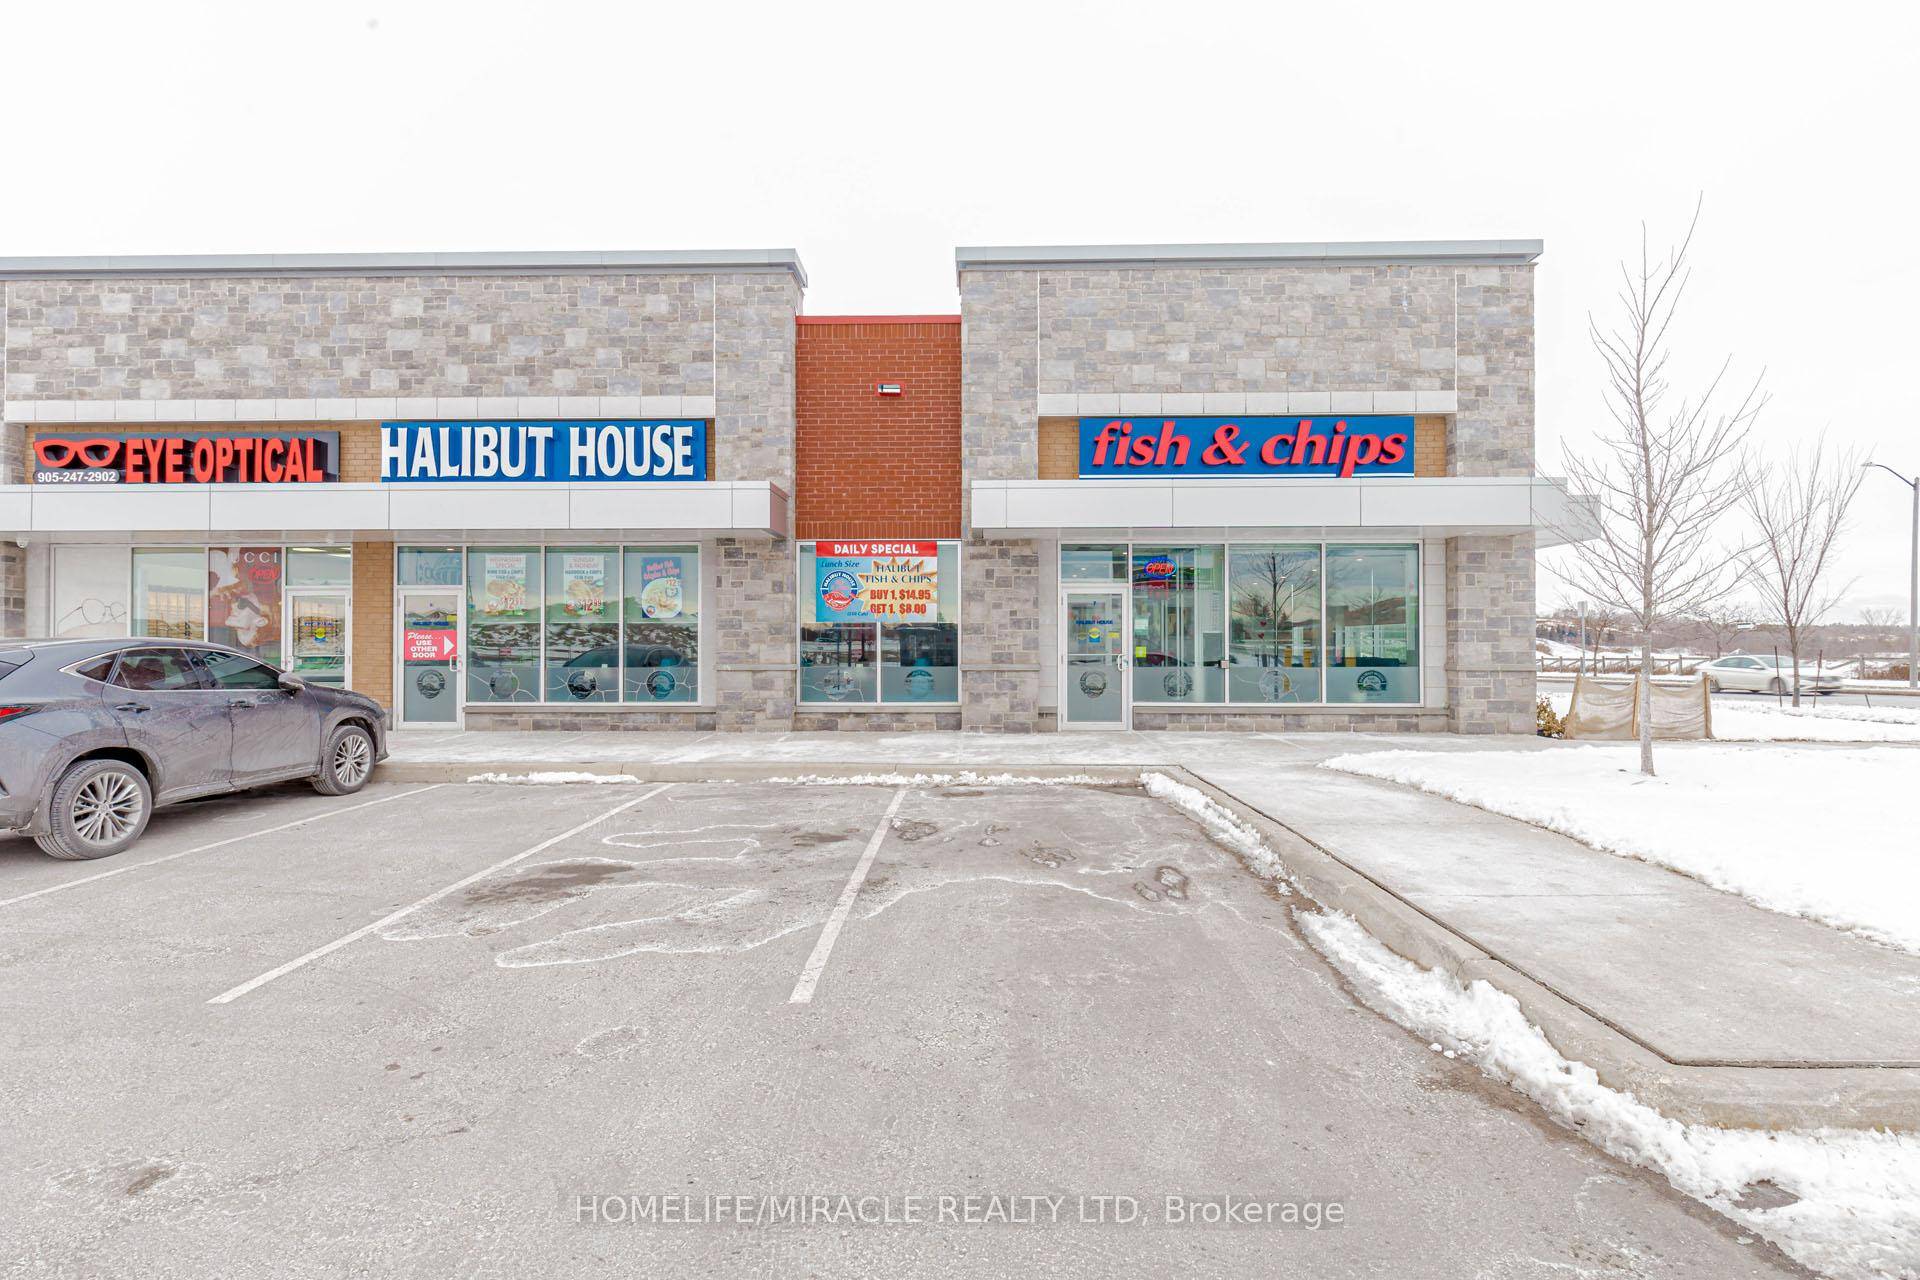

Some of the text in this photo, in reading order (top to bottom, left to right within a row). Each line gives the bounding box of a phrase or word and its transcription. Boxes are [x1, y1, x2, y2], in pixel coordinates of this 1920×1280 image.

[381, 425, 695, 478] HALIBUT HOUSE
[1092, 420, 1407, 478] fish & chips
[125, 436, 324, 484] EYE OPTICAL
[37, 471, 116, 482] 905-247-2902
[834, 543, 919, 554] DAILY SPECIAL
[821, 559, 860, 568] Lunch Size
[1146, 562, 1175, 574] OPEN
[823, 572, 856, 587] HALIBUT HOUSE
[866, 575, 932, 583] FISH & CHIPS
[870, 589, 889, 600] BUY
[899, 588, 931, 600] $14.95
[870, 603, 887, 613] GET
[899, 602, 927, 614] $8.00
